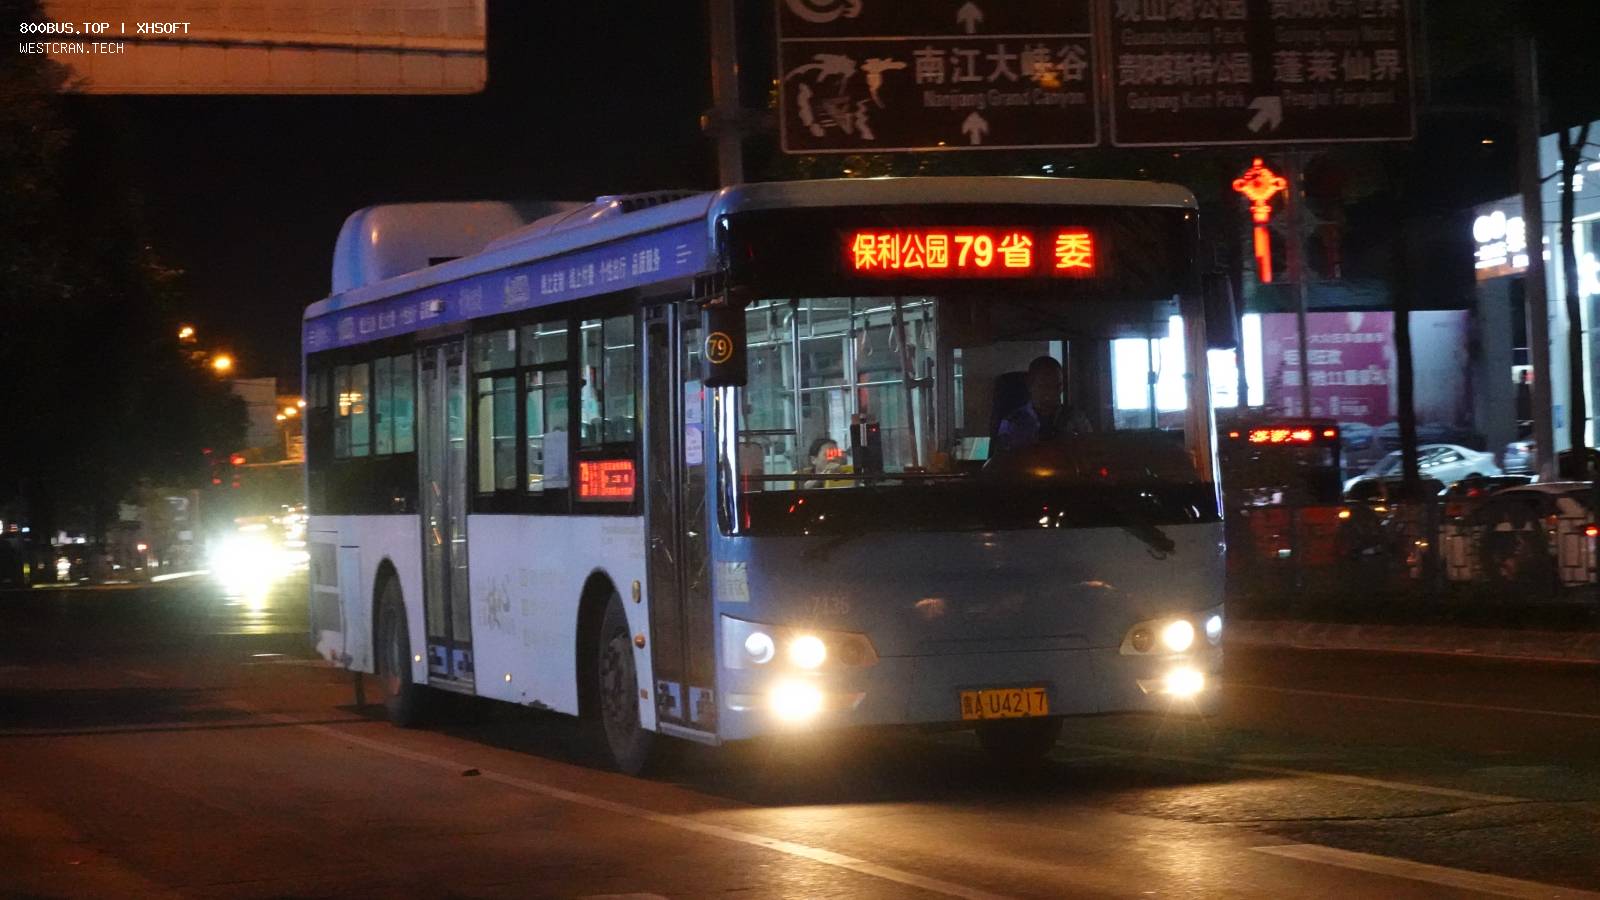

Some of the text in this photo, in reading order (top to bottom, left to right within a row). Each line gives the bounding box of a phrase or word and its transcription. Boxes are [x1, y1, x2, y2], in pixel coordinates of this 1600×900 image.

[912, 44, 1087, 84] 南江大峡谷
[1273, 49, 1403, 83] 蓬莱仙界
[987, 88, 1031, 107] Grand
[852, 234, 948, 270] 保利公园
[954, 235, 993, 267] 79
[709, 339, 727, 356] 79
